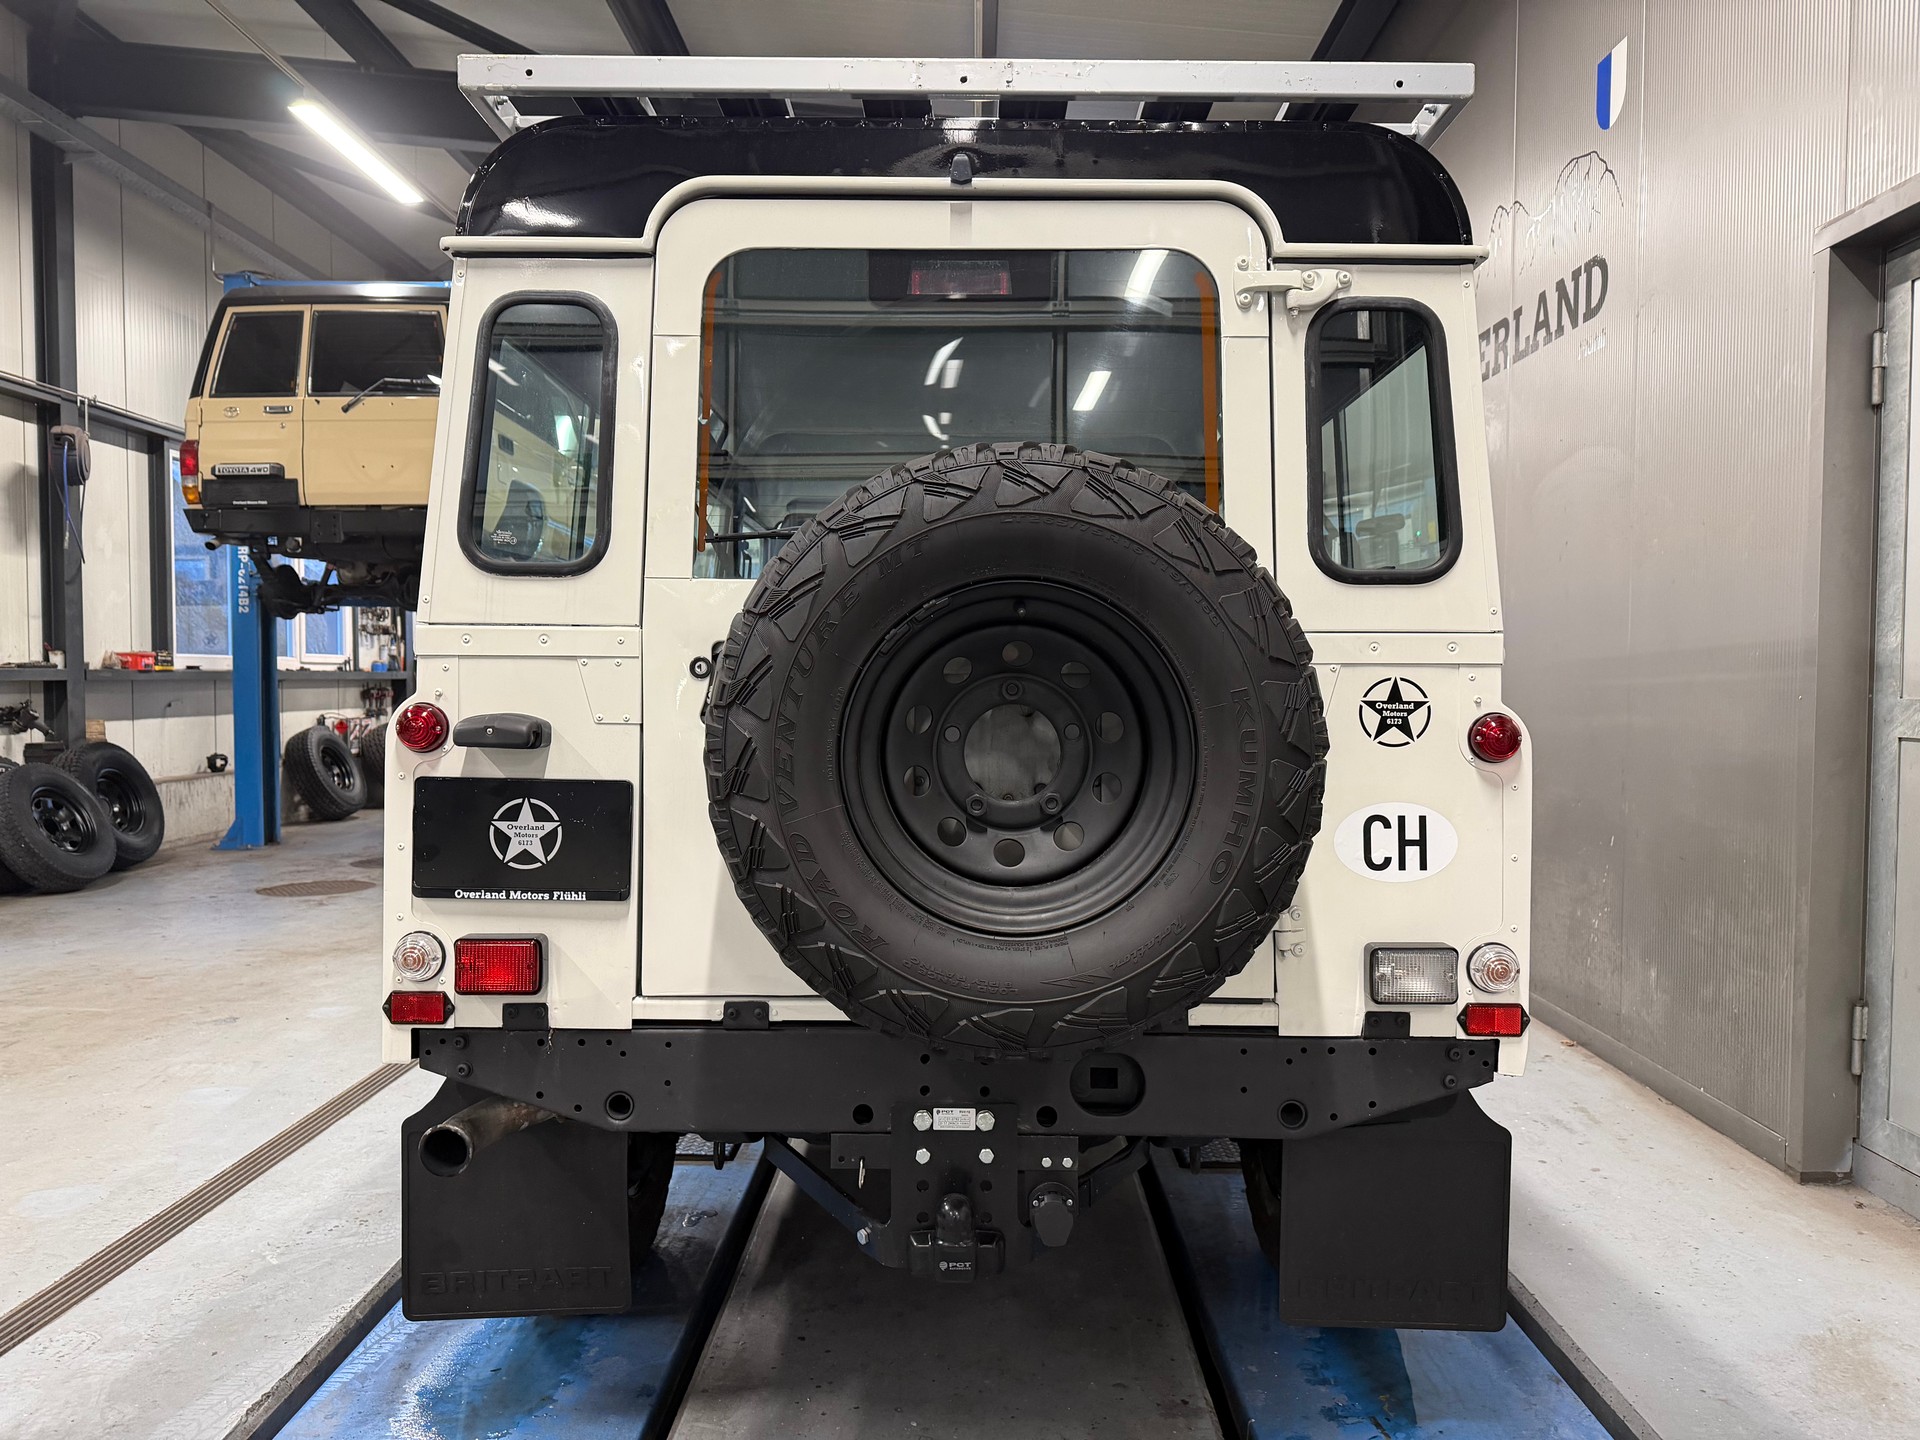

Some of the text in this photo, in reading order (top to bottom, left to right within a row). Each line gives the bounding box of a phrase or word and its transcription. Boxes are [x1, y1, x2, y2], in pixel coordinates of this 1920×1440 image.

[217, 466, 249, 474] TOYOTA
[875, 534, 929, 580] MT
[774, 578, 860, 816] VENTURE
[1375, 702, 1415, 710] Overland
[1209, 687, 1259, 885] KUMHO
[506, 823, 545, 831] Overland
[1362, 814, 1428, 872] CH
[454, 889, 587, 901] Overland Motors Flühli
[788, 832, 889, 952] ROAD
[419, 1265, 615, 1296] BRITPART
